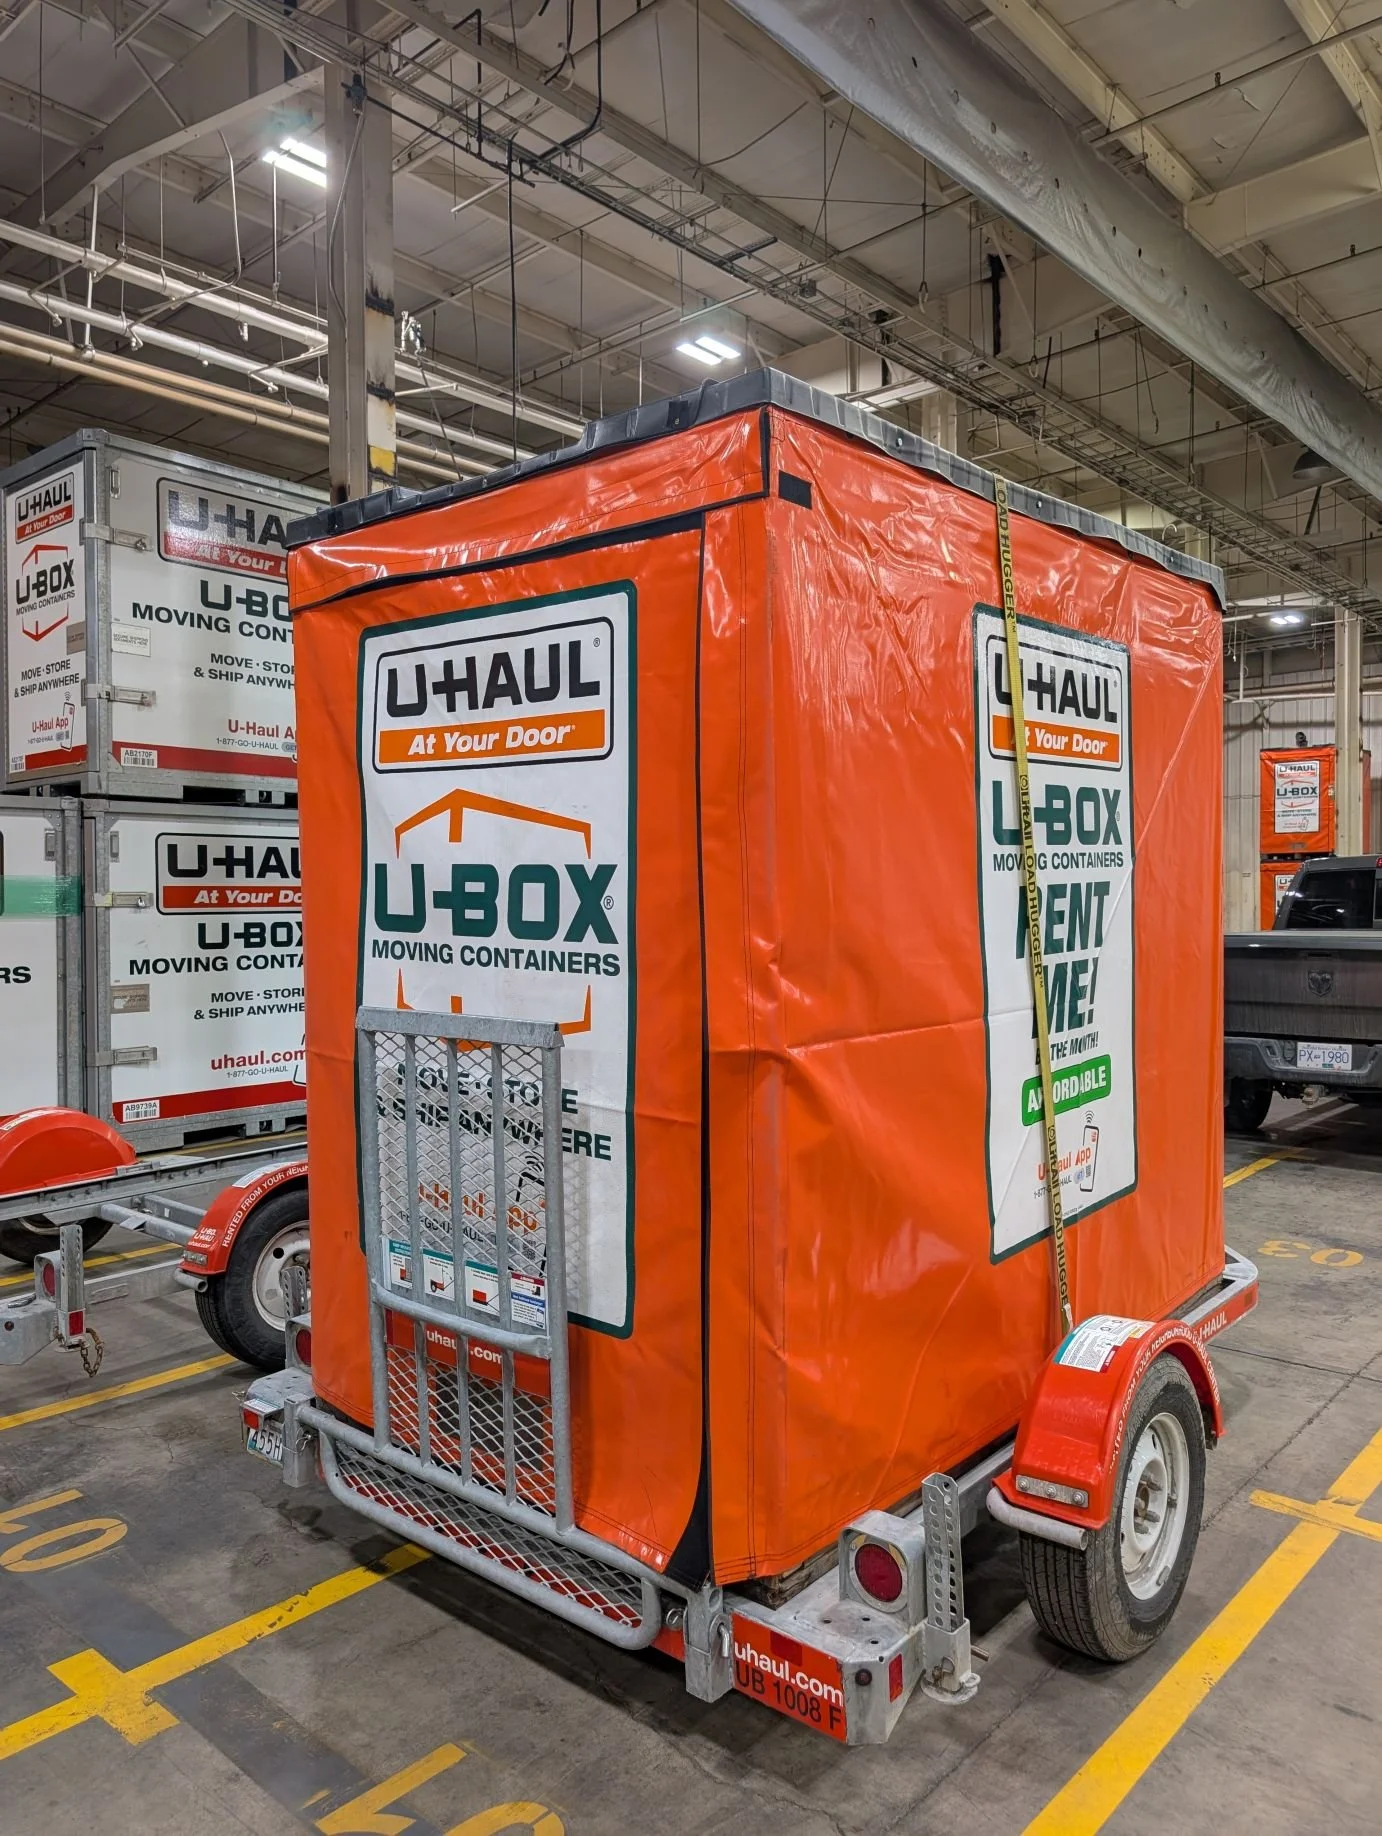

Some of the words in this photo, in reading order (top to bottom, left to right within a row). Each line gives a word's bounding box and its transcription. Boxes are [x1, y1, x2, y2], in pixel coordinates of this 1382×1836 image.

[18, 481, 72, 521] U-HAUL
[25, 524, 32, 536] At
[33, 517, 48, 532] Your
[48, 510, 67, 524] Door
[197, 545, 219, 560] At
[228, 549, 275, 571] Your
[16, 559, 75, 605] U-BOX
[1001, 533, 1016, 619] HUGGER
[16, 602, 38, 616] MOVING
[39, 589, 76, 609] CONTAINERS
[131, 602, 231, 633] MOVING
[21, 667, 42, 681] MOVE
[46, 659, 71, 676] STORE
[210, 653, 253, 669] MOVE
[20, 682, 38, 697] SHIP
[38, 672, 80, 693] ANYWHERE
[193, 667, 204, 678] &
[207, 668, 243, 683] SHIP
[386, 640, 600, 718] U-HAUL
[31, 716, 54, 733] U-Haul
[55, 715, 69, 730] App
[228, 718, 280, 738] U-Haul
[407, 735, 437, 756] At
[443, 730, 500, 753] Your
[505, 725, 572, 749] Door
[1034, 729, 1069, 751] Your
[1071, 733, 1106, 755] Door
[1276, 786, 1318, 797] U-BOX
[1025, 844, 1038, 893] LOAD
[1051, 851, 1125, 871] CONTAINERS
[193, 889, 219, 904] At
[225, 889, 274, 904] Your
[374, 863, 620, 945] U-BOX
[1029, 898, 1043, 977] HUGGER
[129, 955, 229, 975] MOVING
[236, 953, 304, 971] CONT
[372, 939, 454, 964] MOVING
[459, 945, 621, 977] CONTAINERS
[211, 991, 253, 1003] MOVE
[194, 1009, 205, 1020] &
[208, 1006, 244, 1019] SHIP
[1050, 1041, 1068, 1061] THE
[1321, 1051, 1350, 1064] 1980
[1027, 1065, 1107, 1113] AORDABLE
[1074, 1147, 1092, 1167] App
[222, 1211, 243, 1247] RENTED
[241, 1186, 263, 1211] FROM
[262, 1172, 285, 1190] YOUR
[1053, 1192, 1065, 1239] LOAD
[734, 1641, 844, 1707] uhaul.com
[735, 1659, 766, 1695] UB
[773, 1679, 822, 1723] 1008
[828, 1703, 842, 1730] F
